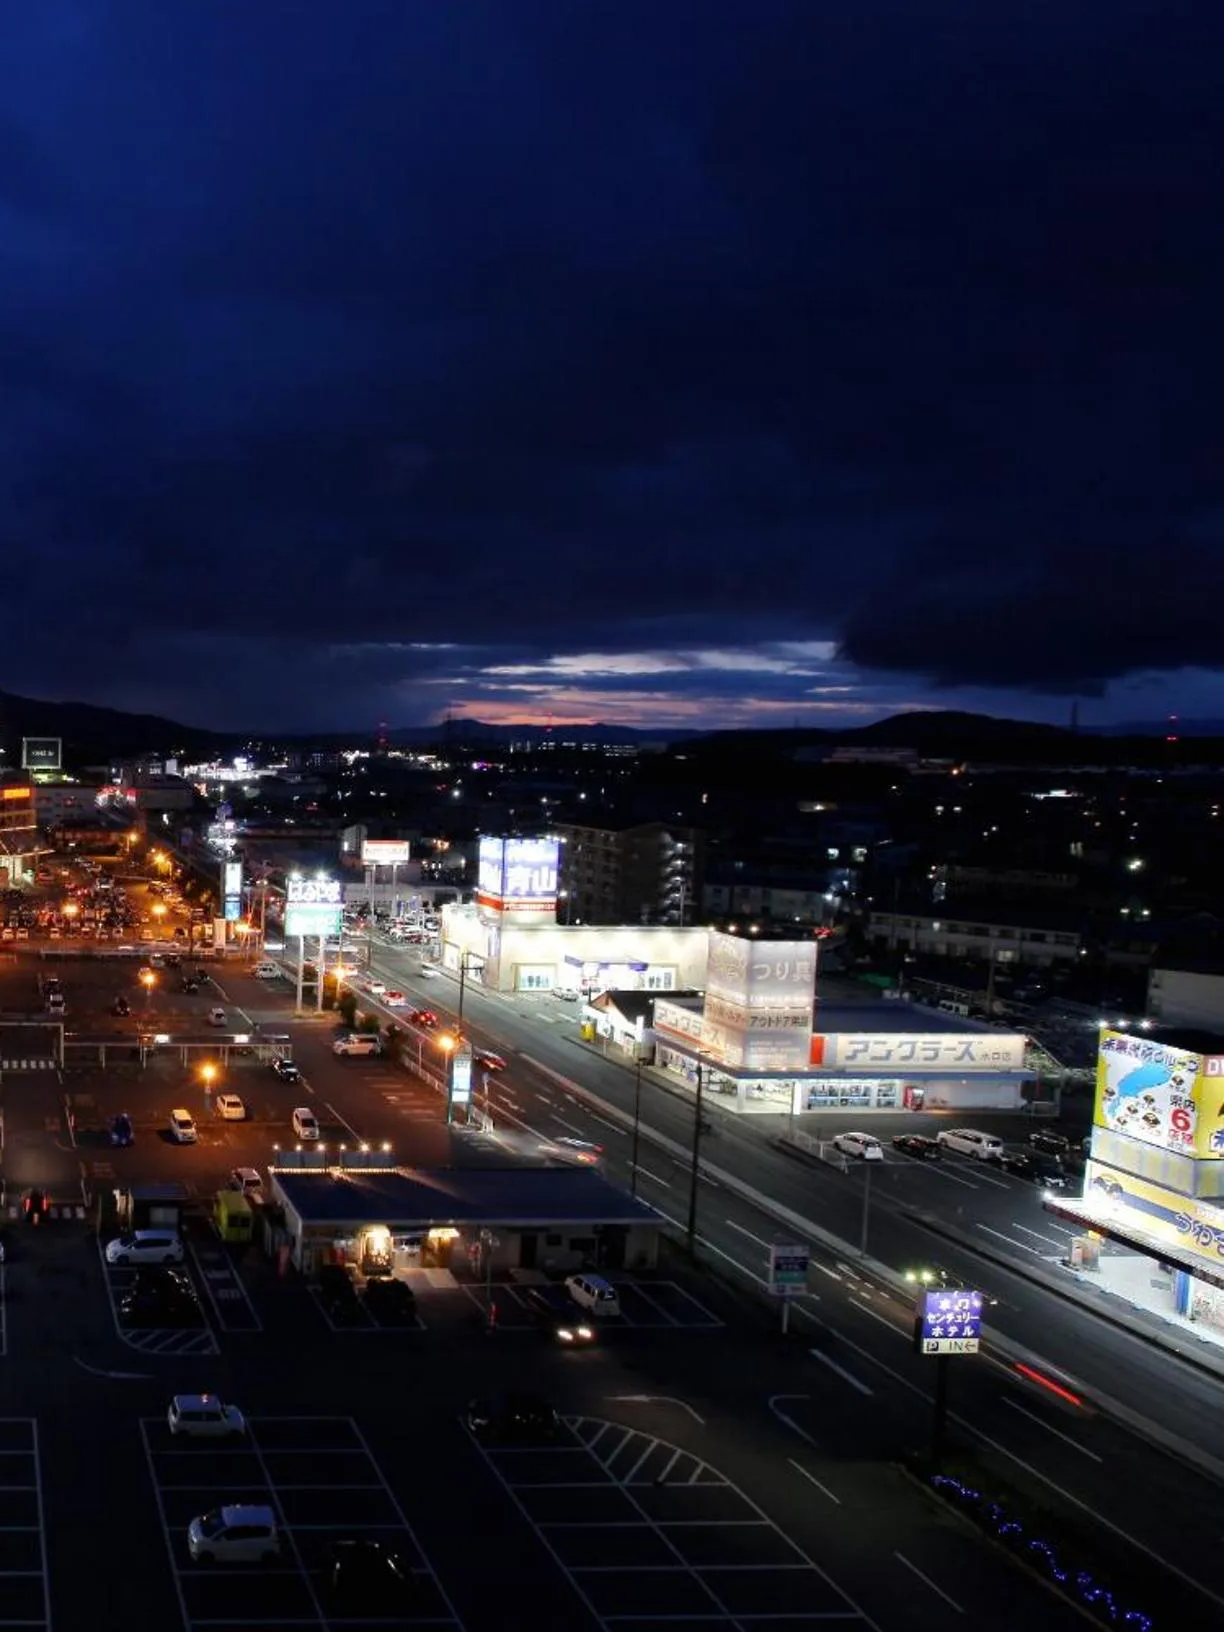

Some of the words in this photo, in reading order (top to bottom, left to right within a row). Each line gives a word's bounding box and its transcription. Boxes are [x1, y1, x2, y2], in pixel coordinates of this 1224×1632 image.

[753, 961, 813, 982] つり具
[1171, 1108, 1191, 1131] 6
[927, 1312, 980, 1324] センチュリー
[932, 1325, 974, 1337] ホテル
[949, 1341, 964, 1351] IN
